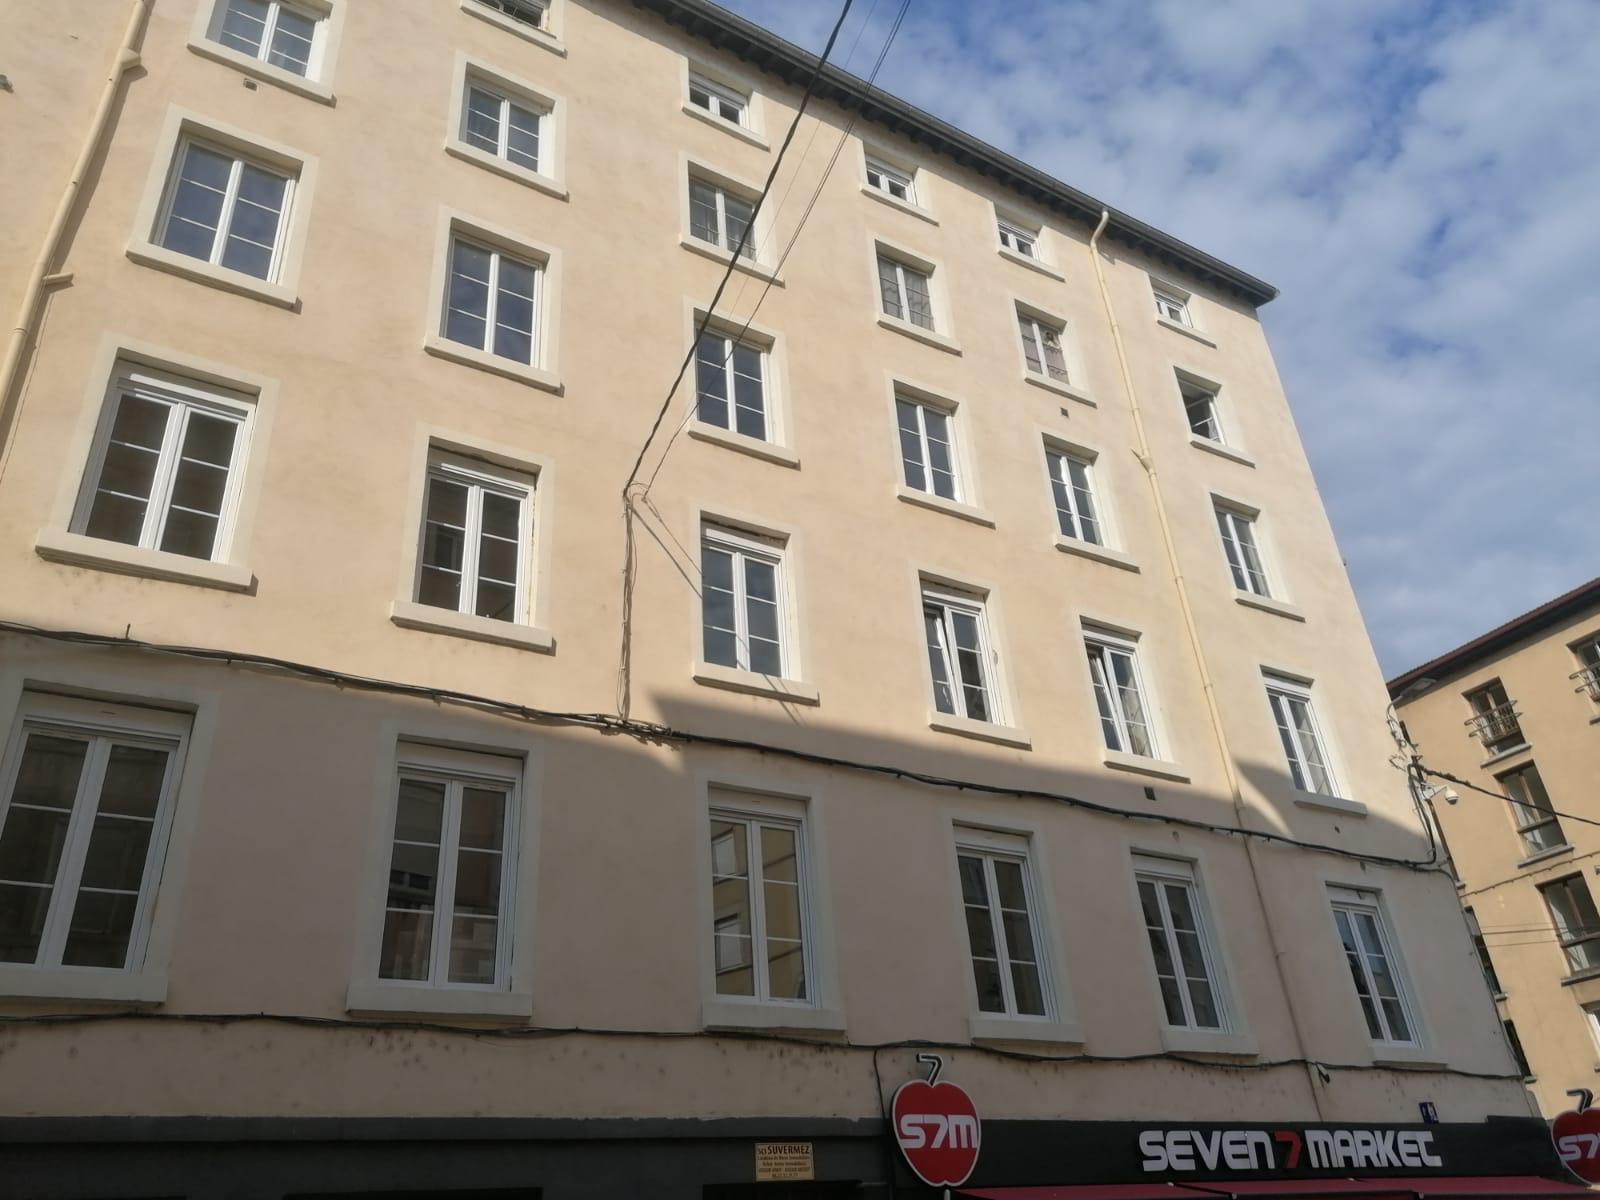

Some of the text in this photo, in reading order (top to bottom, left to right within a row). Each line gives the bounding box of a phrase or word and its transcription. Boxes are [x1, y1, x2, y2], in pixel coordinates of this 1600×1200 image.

[899, 1113, 978, 1149] S7M
[1559, 1132, 1600, 1161] S7
[767, 1145, 810, 1155] SUVERMEZ
[1139, 1130, 1443, 1171] SEVEN 7 MARKET
